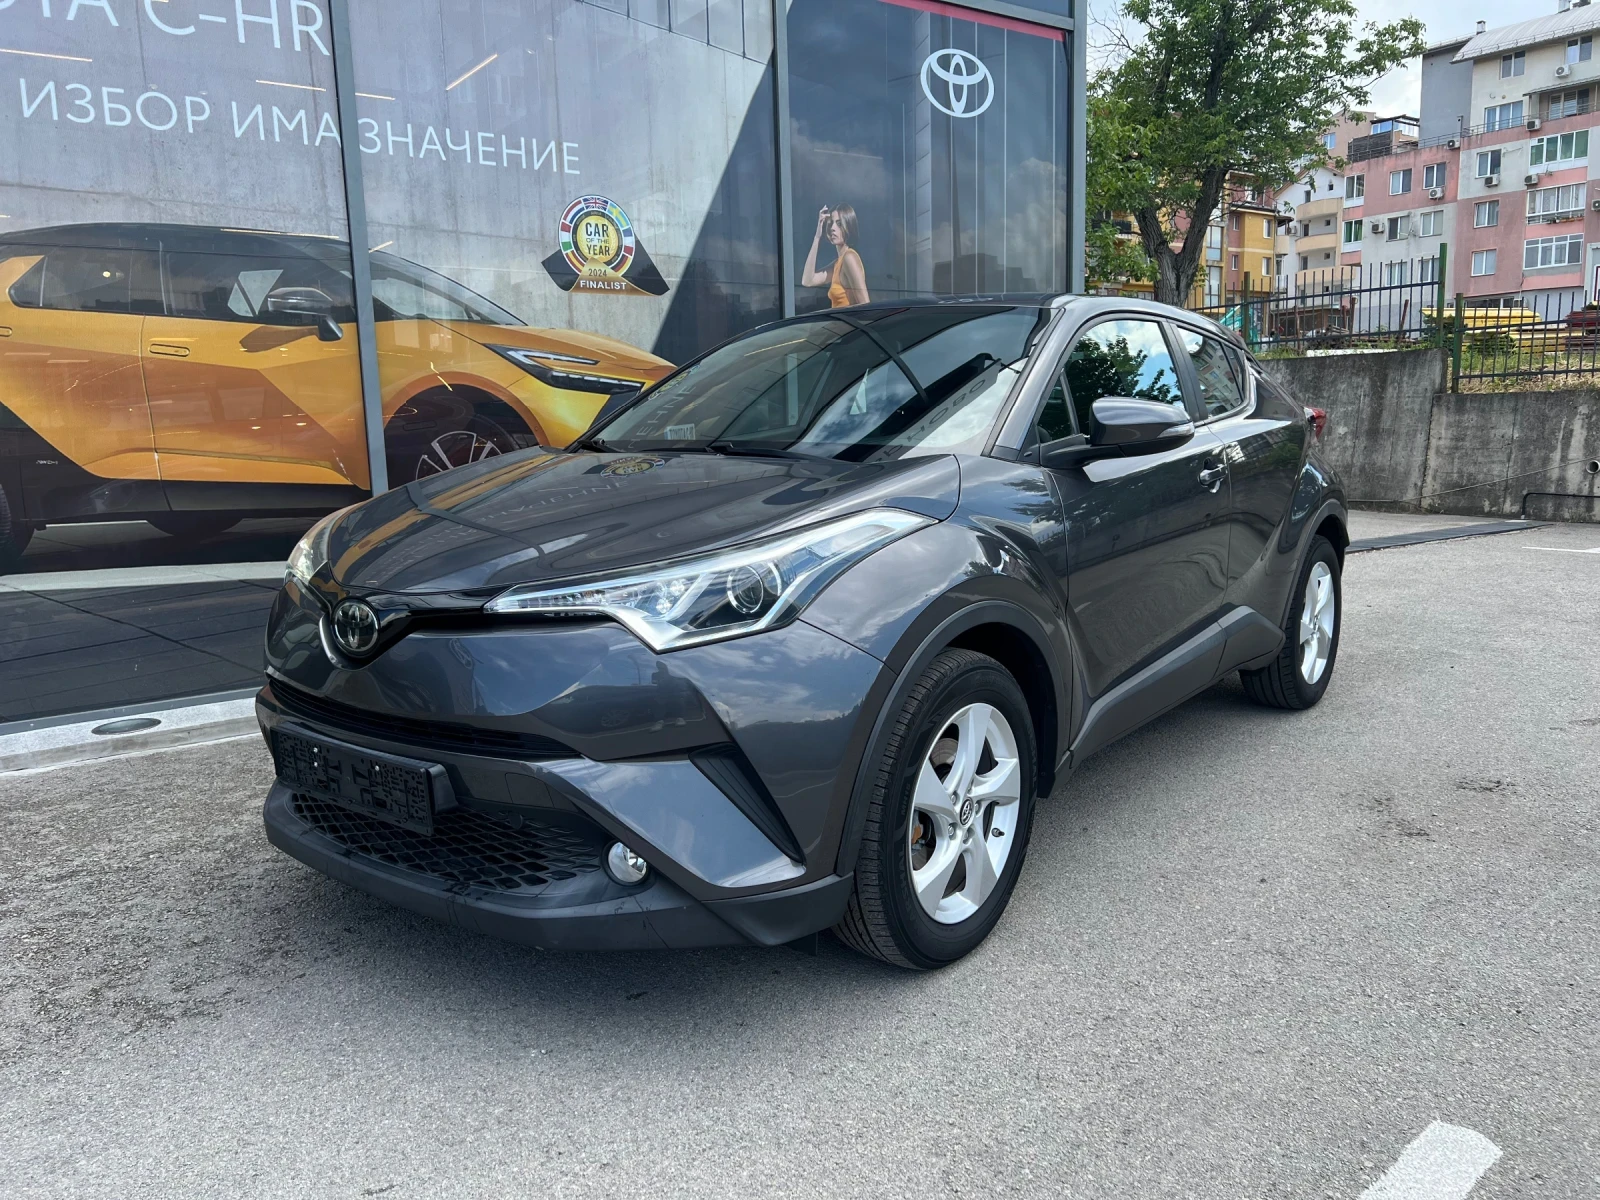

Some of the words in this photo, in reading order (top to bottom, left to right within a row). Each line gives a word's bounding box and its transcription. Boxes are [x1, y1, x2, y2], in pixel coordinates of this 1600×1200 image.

[19, 78, 211, 133] ИЗБОР
[231, 101, 342, 147] ИМА
[358, 118, 581, 174] ЗНАЧЕНИЕ
[585, 222, 609, 238] CAR
[586, 244, 611, 257] YEAR
[588, 268, 608, 277] 2024
[580, 280, 627, 290] FINALIST
